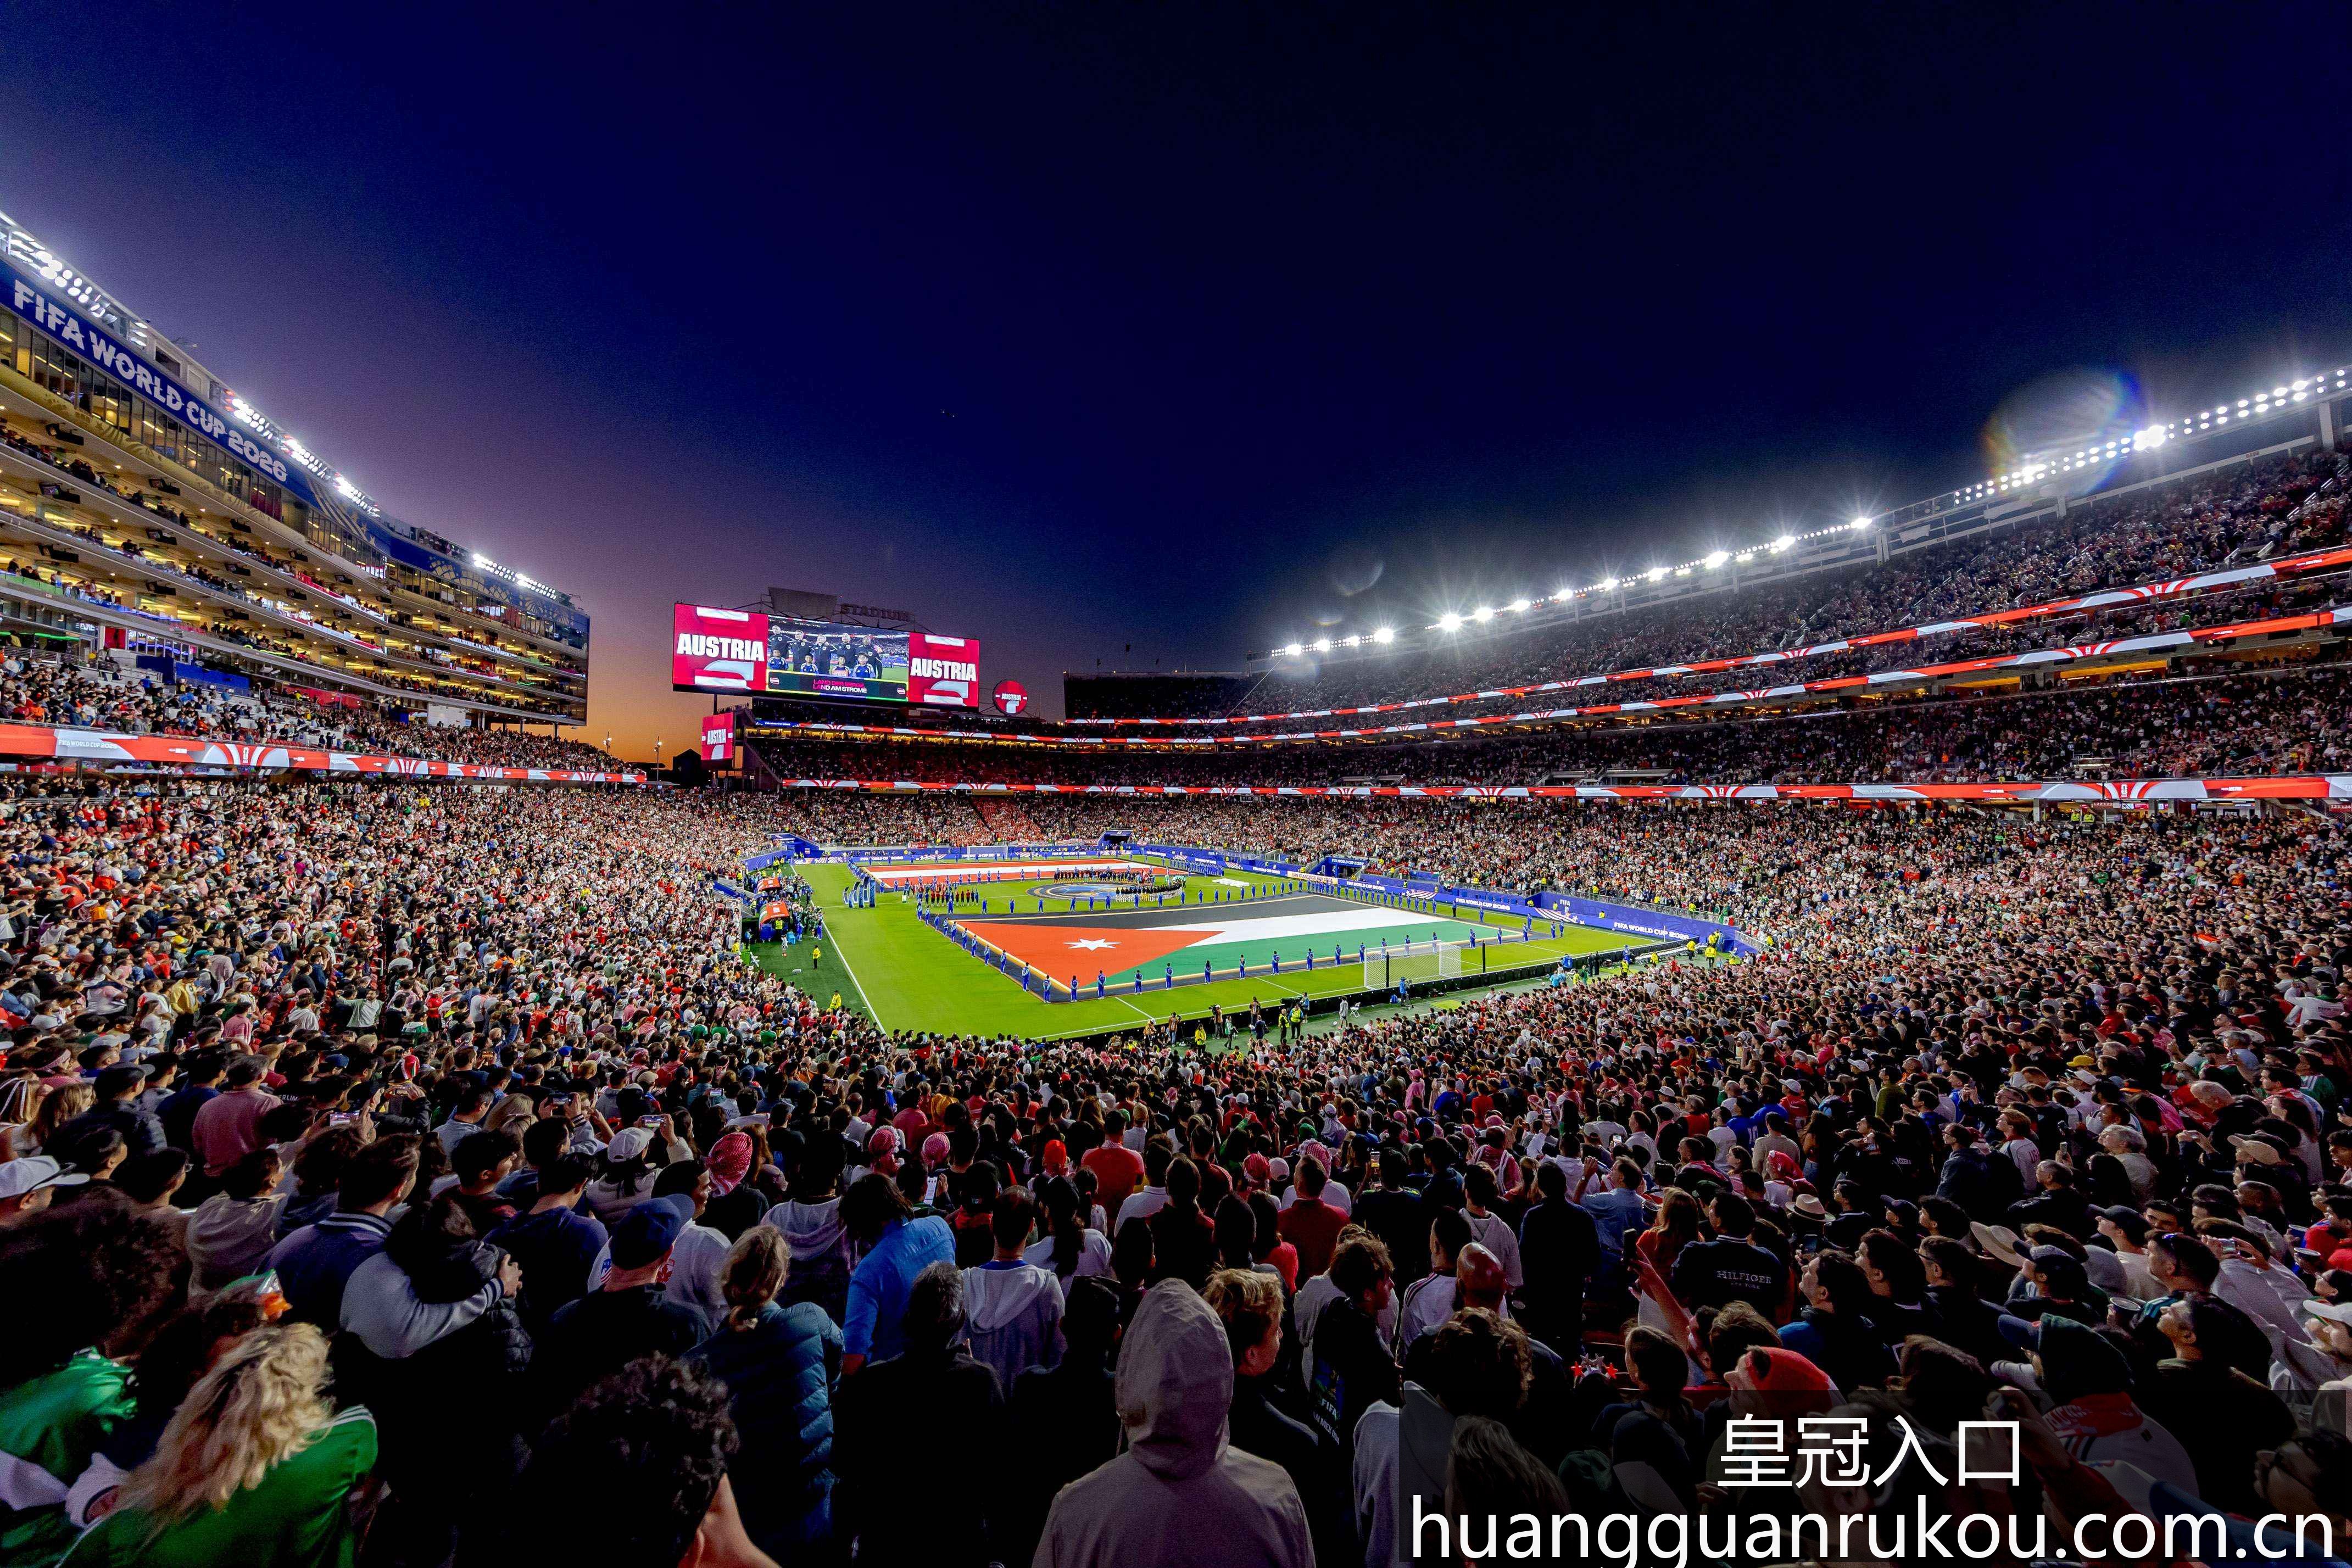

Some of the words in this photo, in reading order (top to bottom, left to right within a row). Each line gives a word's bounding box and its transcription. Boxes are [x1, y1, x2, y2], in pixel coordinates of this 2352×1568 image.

[14, 280, 85, 350] FIFA
[89, 330, 184, 411] WORLD
[186, 401, 227, 439] CUP
[228, 429, 287, 482] 2026
[841, 603, 910, 622] STADIUM
[677, 633, 765, 662] AUSTRIA
[910, 658, 977, 682] AUSTRIA
[707, 728, 726, 745] AUSTRIA
[1629, 924, 1653, 934] WORLD
[1668, 931, 1689, 940] 2026
[1717, 1270, 1771, 1284] HILFIGER
[1320, 1398, 1336, 1421] FIFA
